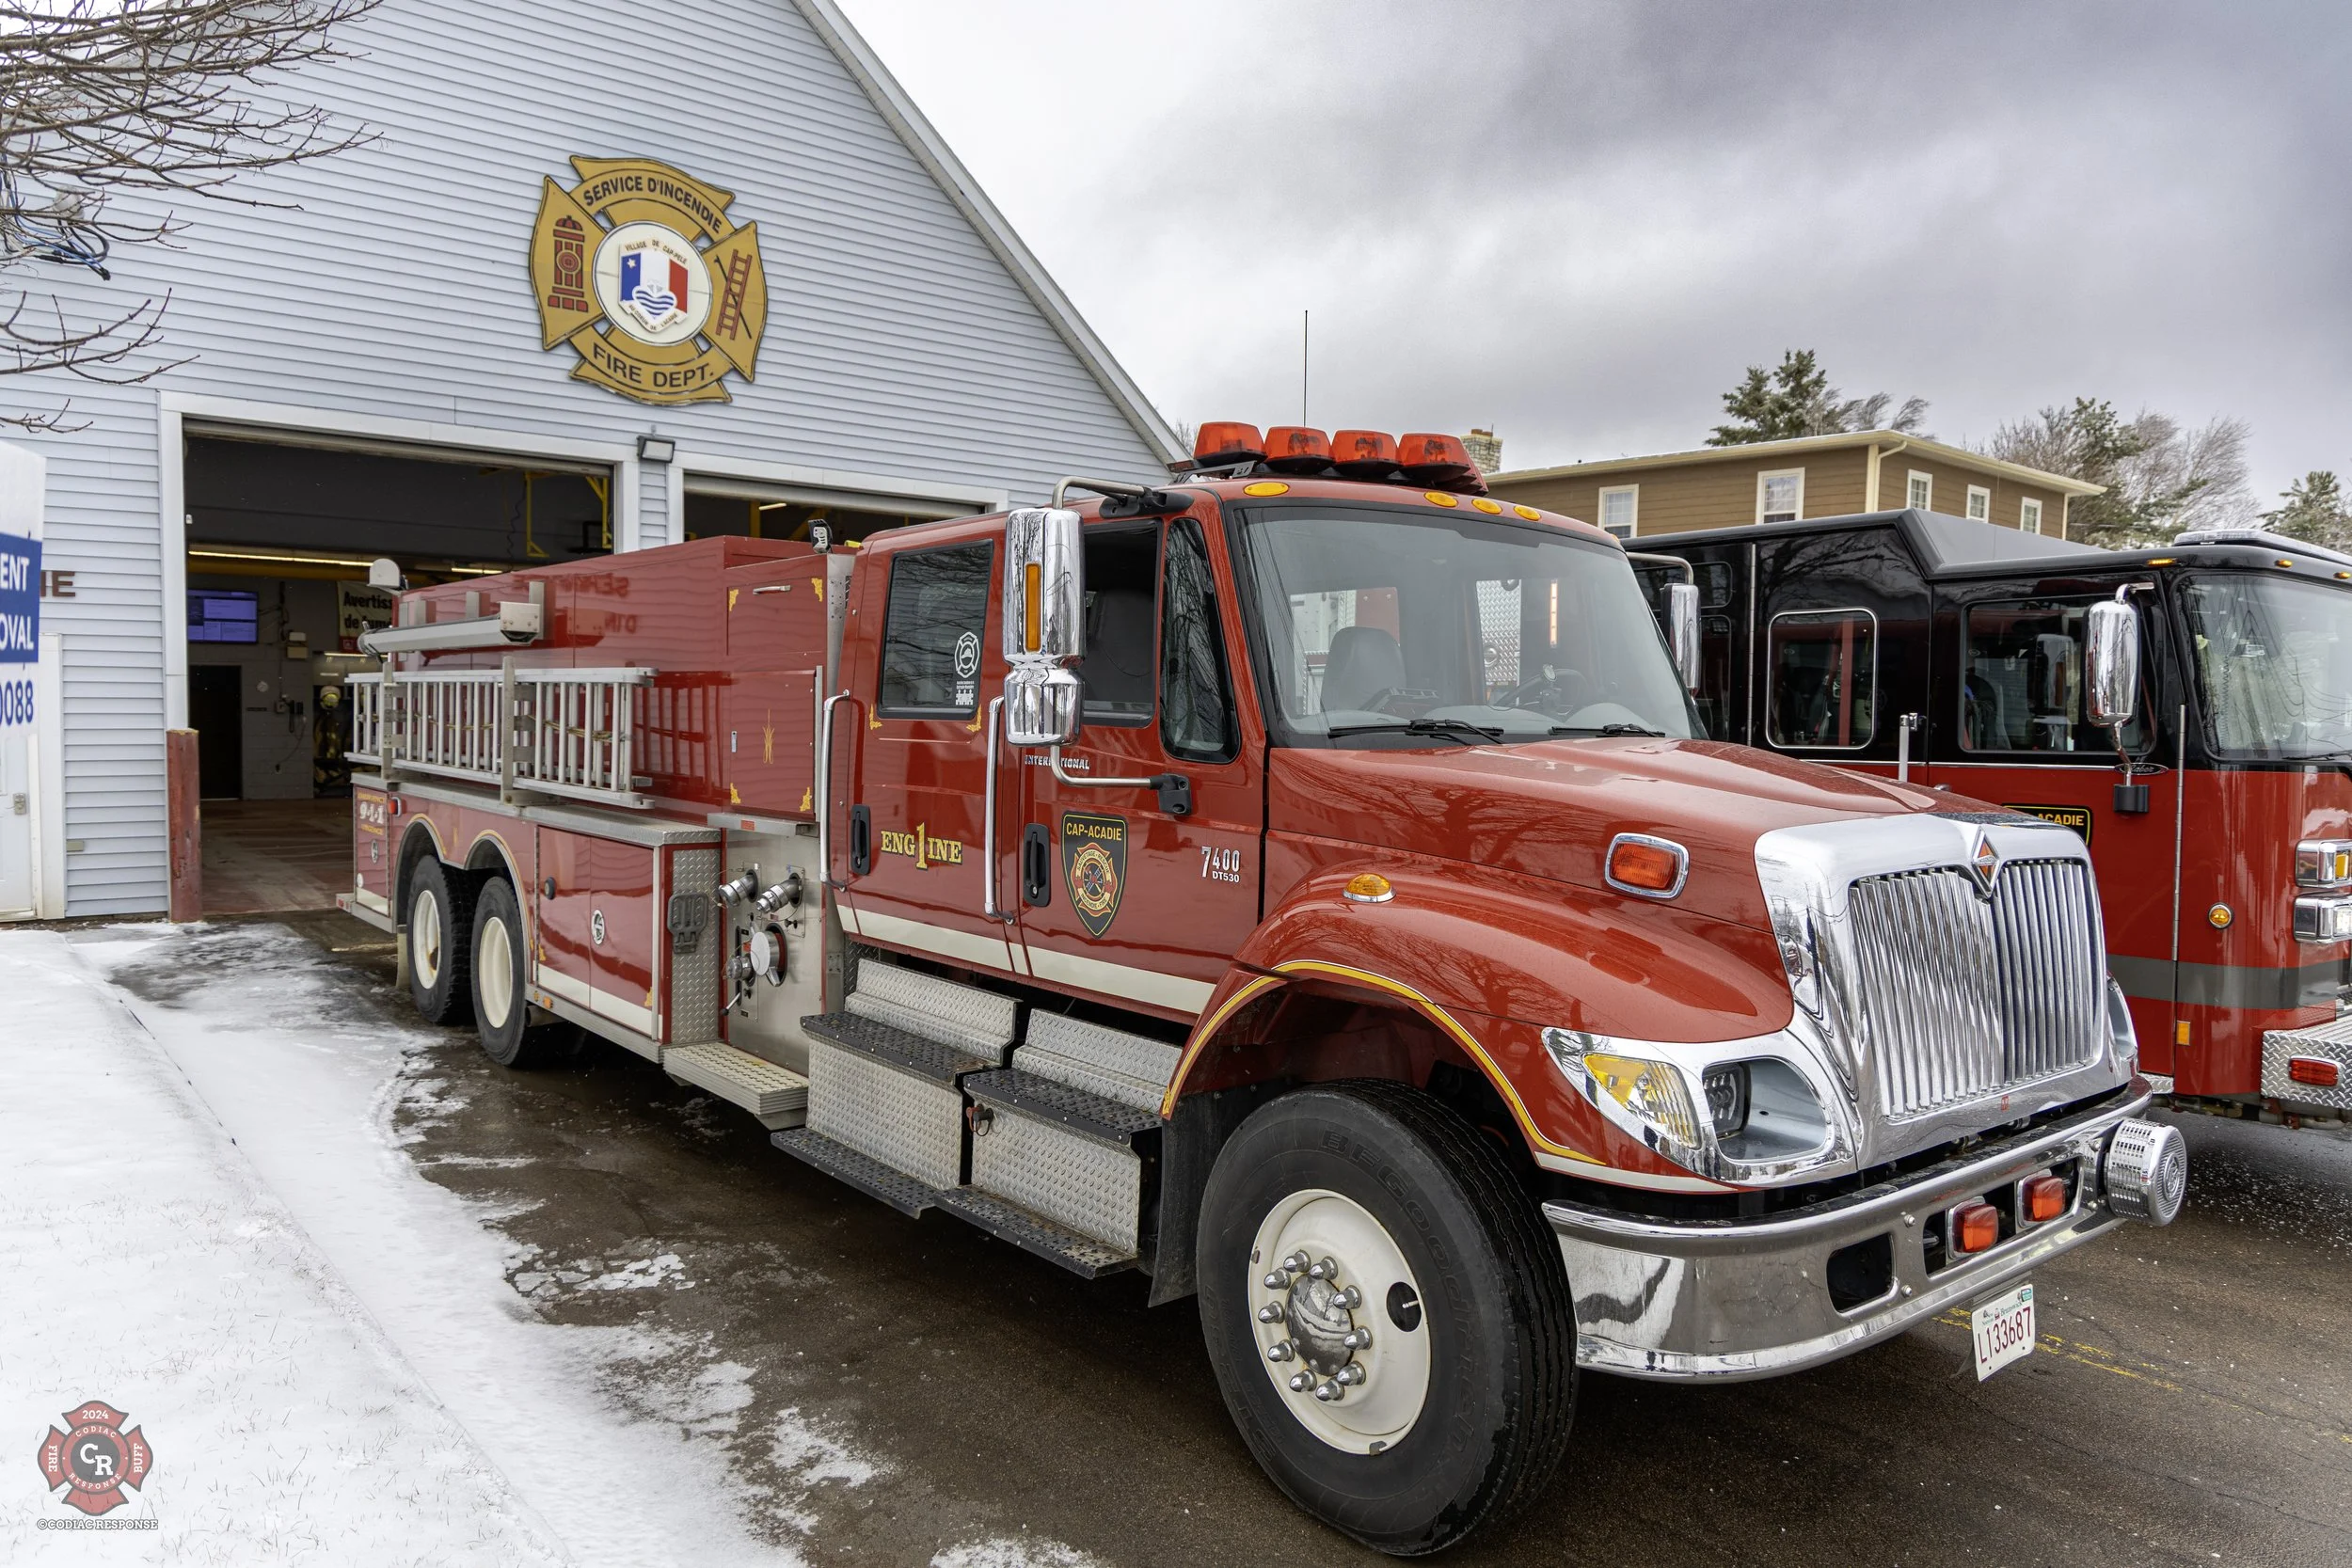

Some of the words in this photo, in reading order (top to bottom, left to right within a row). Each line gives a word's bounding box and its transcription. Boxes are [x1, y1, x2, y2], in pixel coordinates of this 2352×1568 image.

[582, 176, 644, 207] SERVICE
[647, 179, 723, 234] D'INCENDIE
[625, 241, 647, 251] VILLAGE
[651, 239, 660, 247] DE
[593, 341, 643, 384] FIRE
[653, 362, 714, 388] DEPT.
[0, 552, 30, 592] ENT
[344, 613, 359, 628] de
[0, 679, 34, 726] 088
[1025, 754, 1090, 770] INTERTIONAL
[1066, 822, 1122, 841] CAP-ACADIE
[2036, 813, 2085, 826] ACADIE
[1200, 846, 1240, 878] 7400
[1212, 871, 1240, 882] DT530
[1978, 1306, 2031, 1364] L133687
